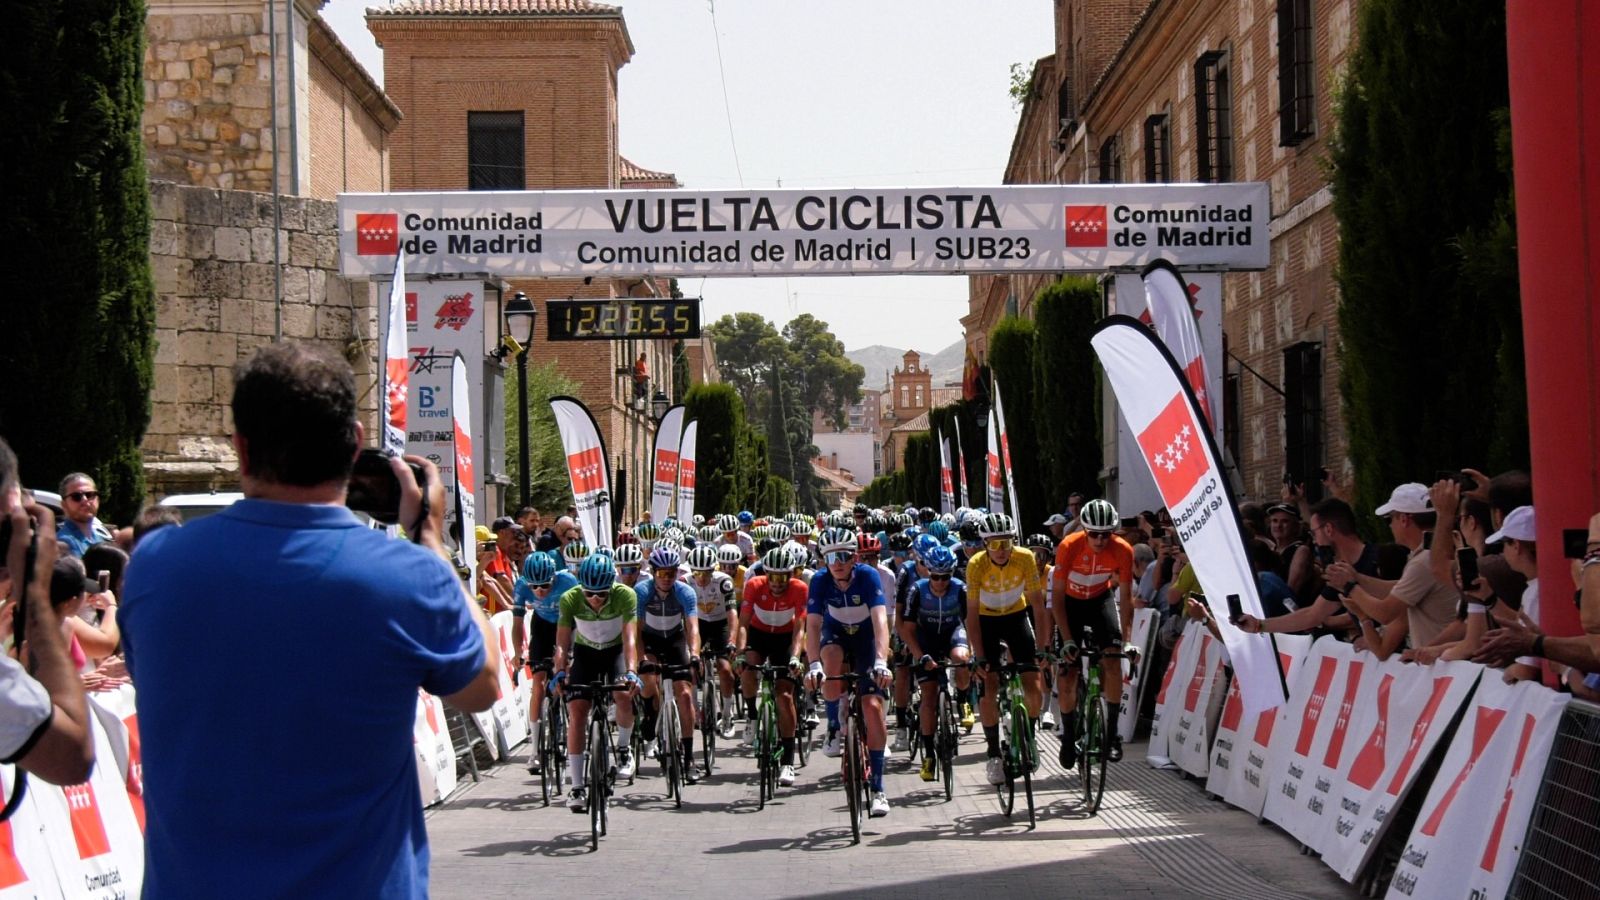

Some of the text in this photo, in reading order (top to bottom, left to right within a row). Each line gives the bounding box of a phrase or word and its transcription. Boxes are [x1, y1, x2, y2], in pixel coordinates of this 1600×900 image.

[404, 212, 542, 231] Comunidad
[604, 194, 1002, 233] VUELTA CICLISTA
[1113, 204, 1252, 224] Comunidad
[404, 233, 542, 255] de Madrid
[1113, 226, 1252, 247] de Madrid
[577, 240, 740, 264] Comunidad
[750, 240, 785, 262] de
[794, 238, 891, 261] Madrid
[935, 236, 1031, 260] SUB23
[419, 386, 435, 408] B
[418, 408, 448, 418] travel
